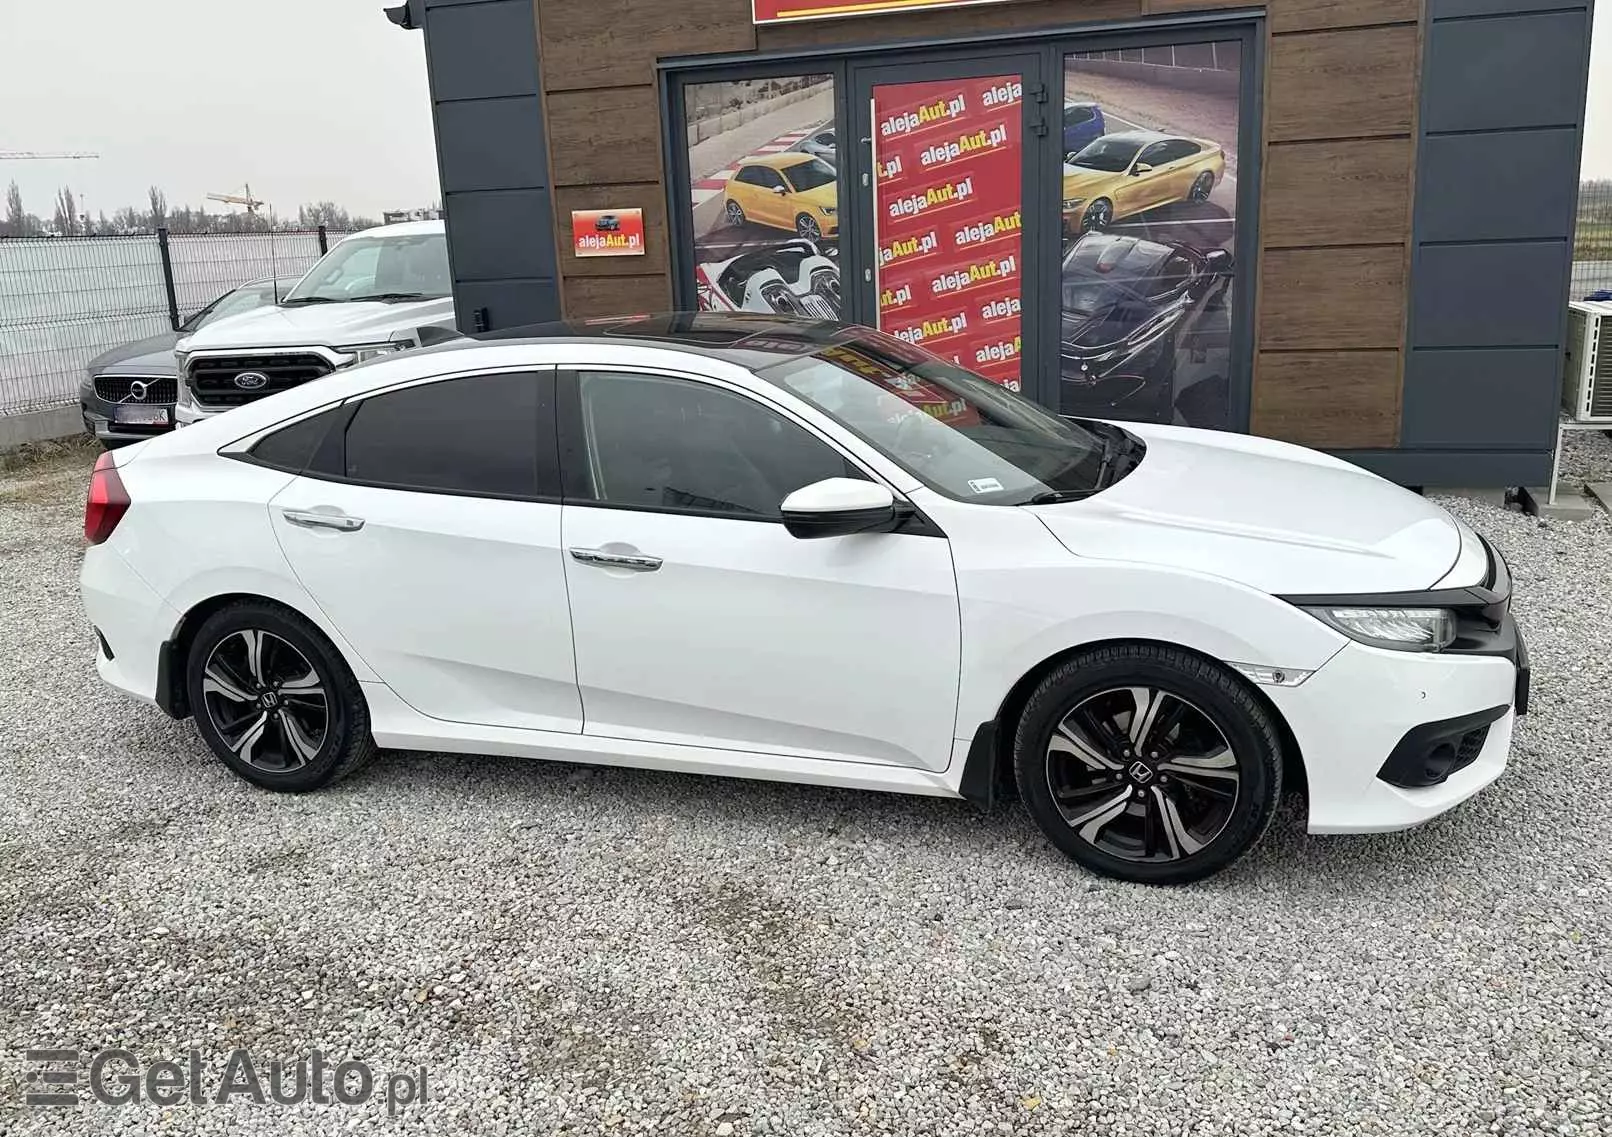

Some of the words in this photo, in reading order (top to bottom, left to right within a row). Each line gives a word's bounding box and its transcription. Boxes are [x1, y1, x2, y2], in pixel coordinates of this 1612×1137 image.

[982, 81, 1022, 106] aleja
[880, 94, 966, 136] alejaAut.pl
[920, 124, 1007, 166] alejaAut.pl
[889, 177, 973, 217] alejaAut.pl
[579, 233, 640, 249] alejaAut.pl
[931, 255, 1016, 293] alejaAut.pl
[982, 297, 1021, 319] aleja
[893, 312, 967, 344] lejaAut.pl
